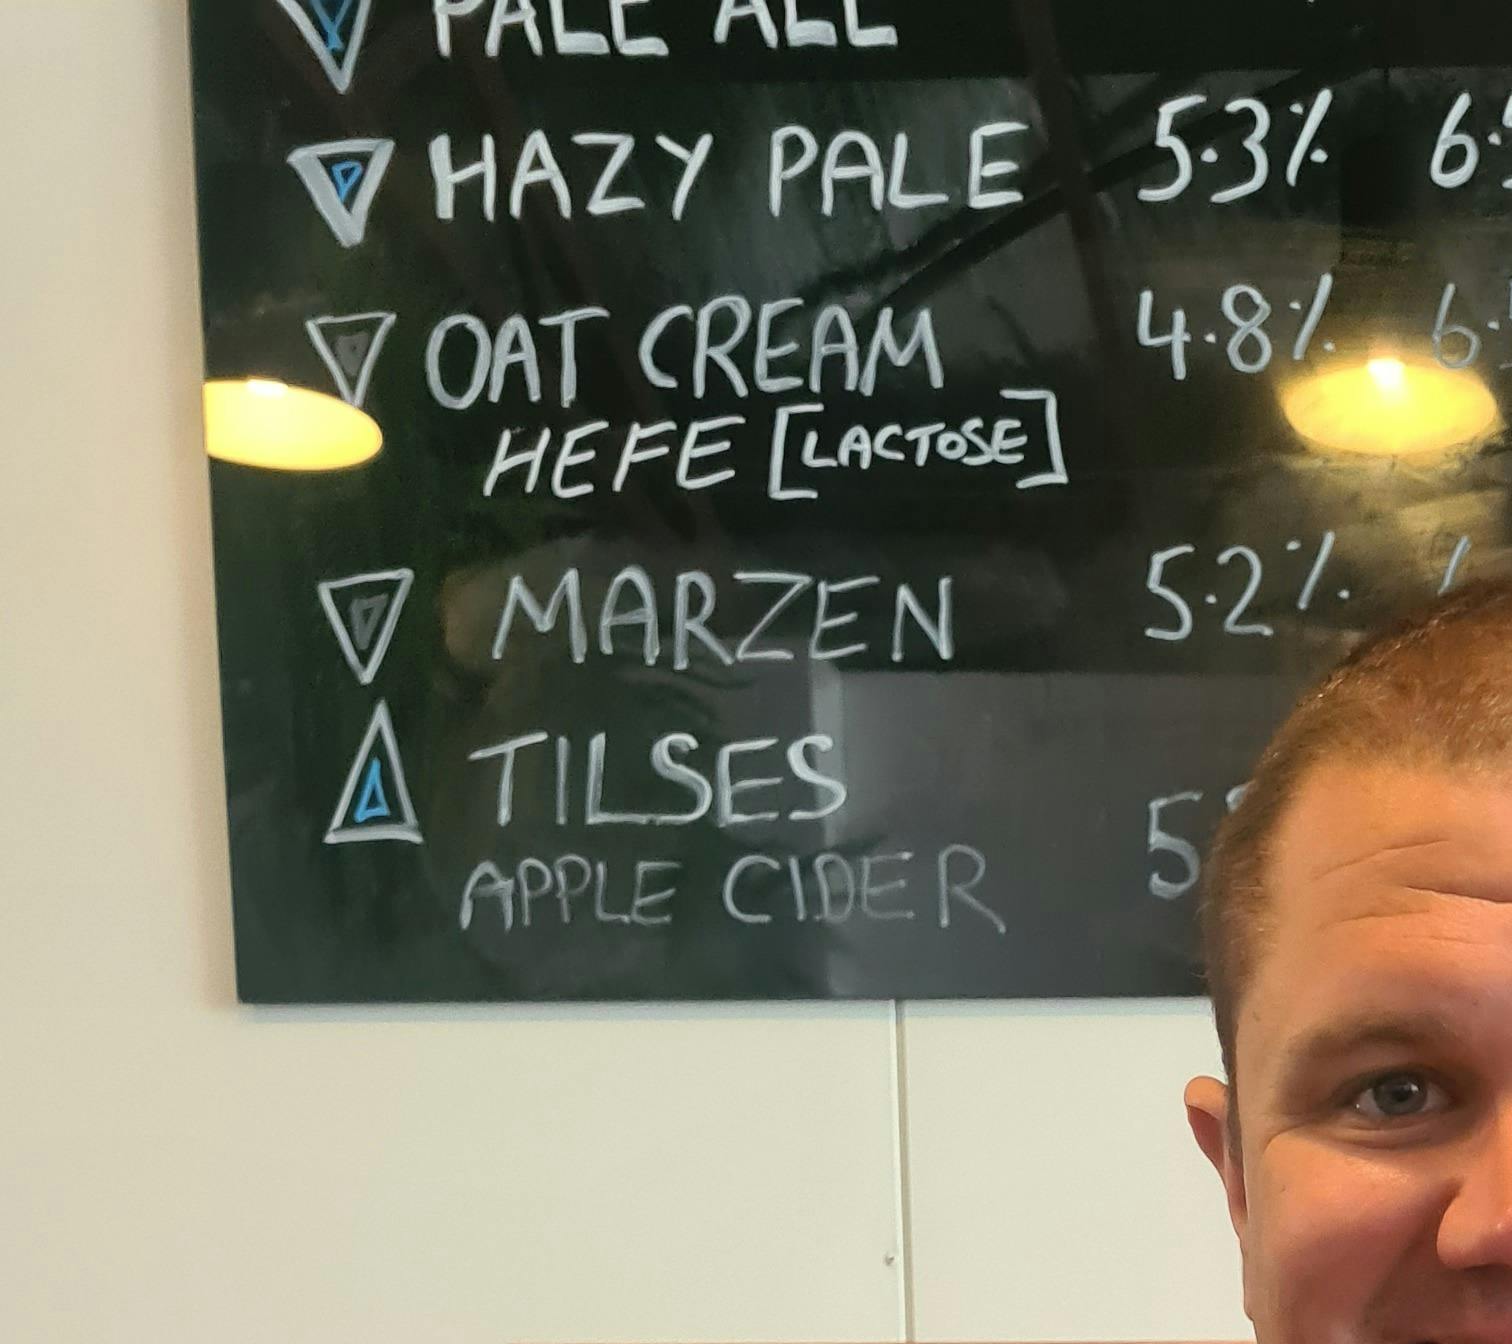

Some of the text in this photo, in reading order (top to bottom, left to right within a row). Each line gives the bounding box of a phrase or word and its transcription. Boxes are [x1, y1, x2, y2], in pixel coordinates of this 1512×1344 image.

[428, 121, 1031, 220] HAZY PALE
[425, 294, 944, 410] OAT CREAM
[482, 389, 1069, 501] HEFE [LACTOSE]
[490, 564, 954, 670] MARZEN
[468, 729, 848, 828] TILSES
[458, 844, 1007, 935] APPLE CIDER
